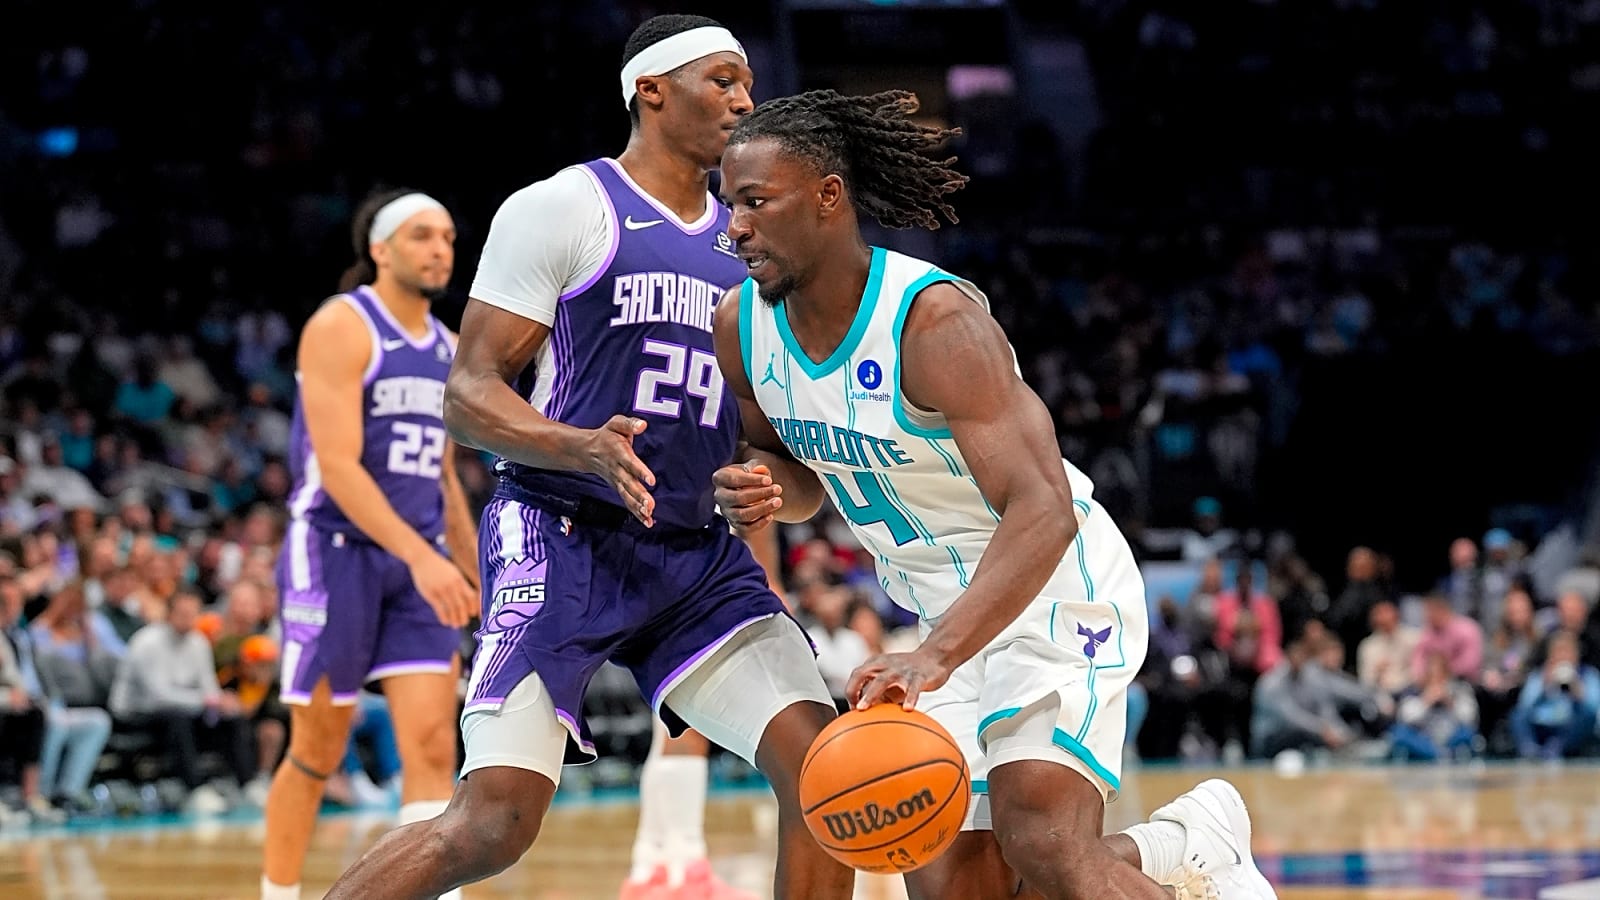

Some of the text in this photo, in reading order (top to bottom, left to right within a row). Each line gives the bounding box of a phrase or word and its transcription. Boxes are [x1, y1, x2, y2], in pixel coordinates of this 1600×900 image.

[609, 272, 726, 333] SACRAME
[632, 338, 726, 430] 29
[849, 391, 892, 402] Judi Health
[387, 420, 446, 480] 22
[823, 471, 919, 547] 4
[489, 584, 545, 617] NGS
[822, 787, 936, 841] Wilson
